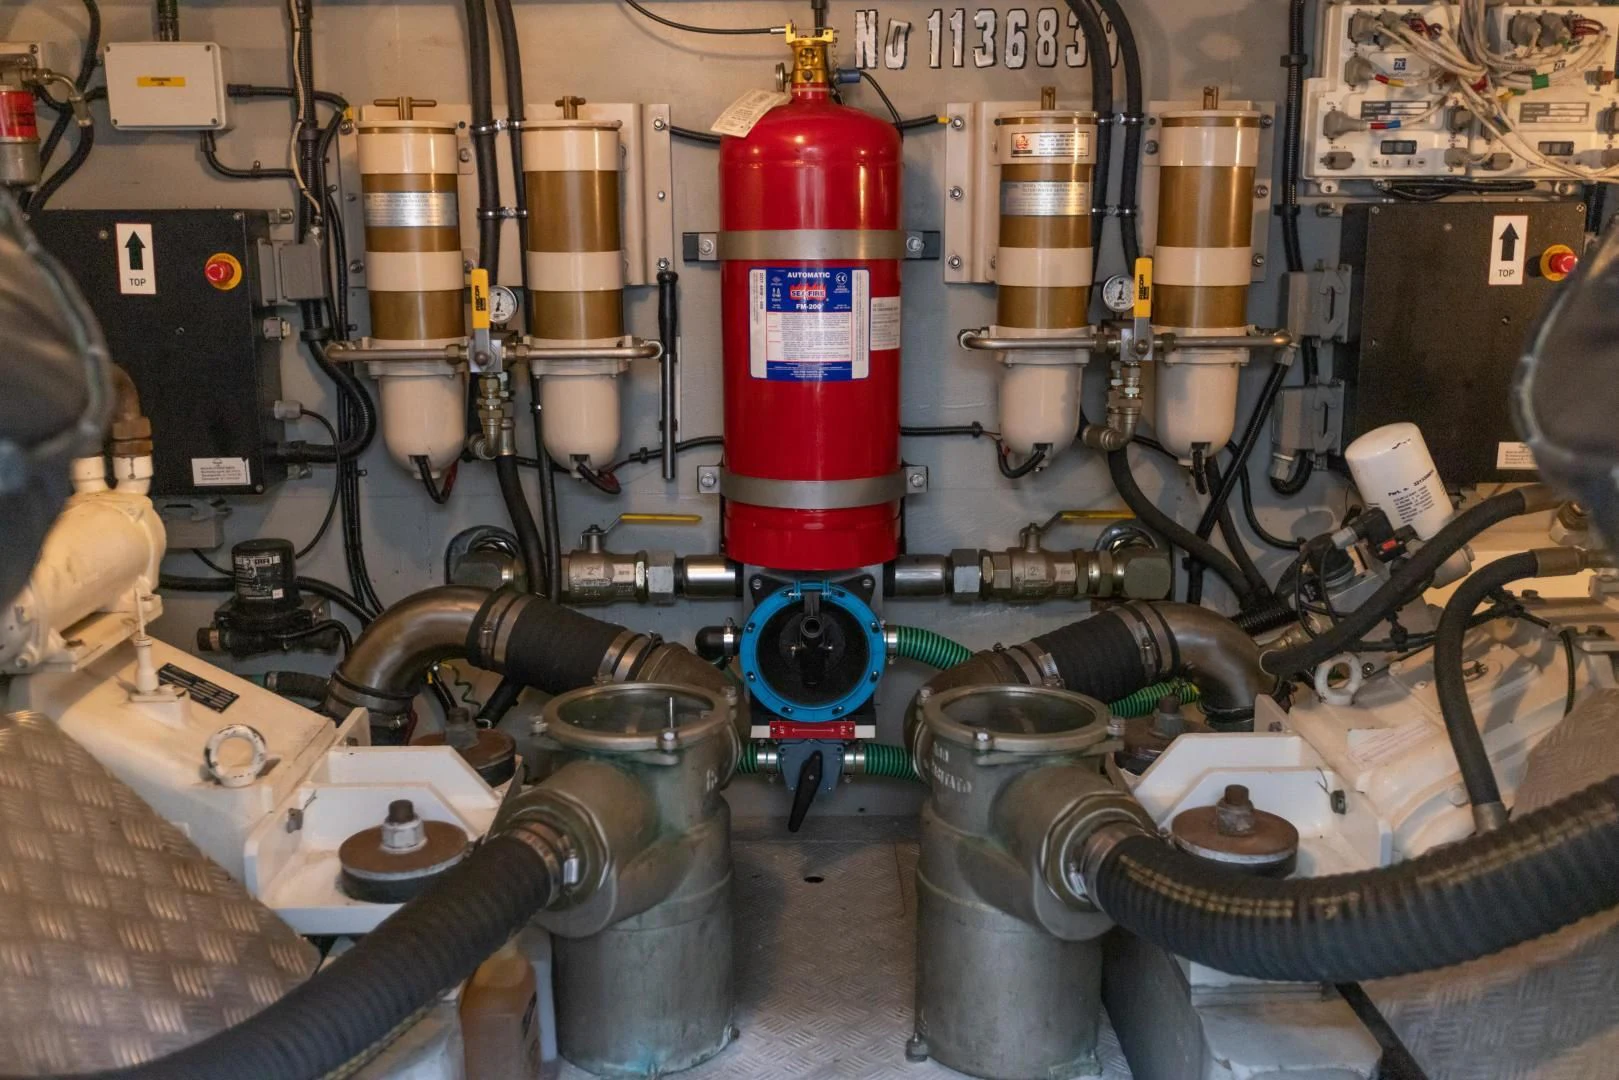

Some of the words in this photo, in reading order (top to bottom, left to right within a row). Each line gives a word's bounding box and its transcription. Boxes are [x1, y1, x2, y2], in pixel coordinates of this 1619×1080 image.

[787, 271, 831, 279] AUTOMATIC
[1498, 269, 1515, 277] TOP
[129, 278, 147, 286] TOP
